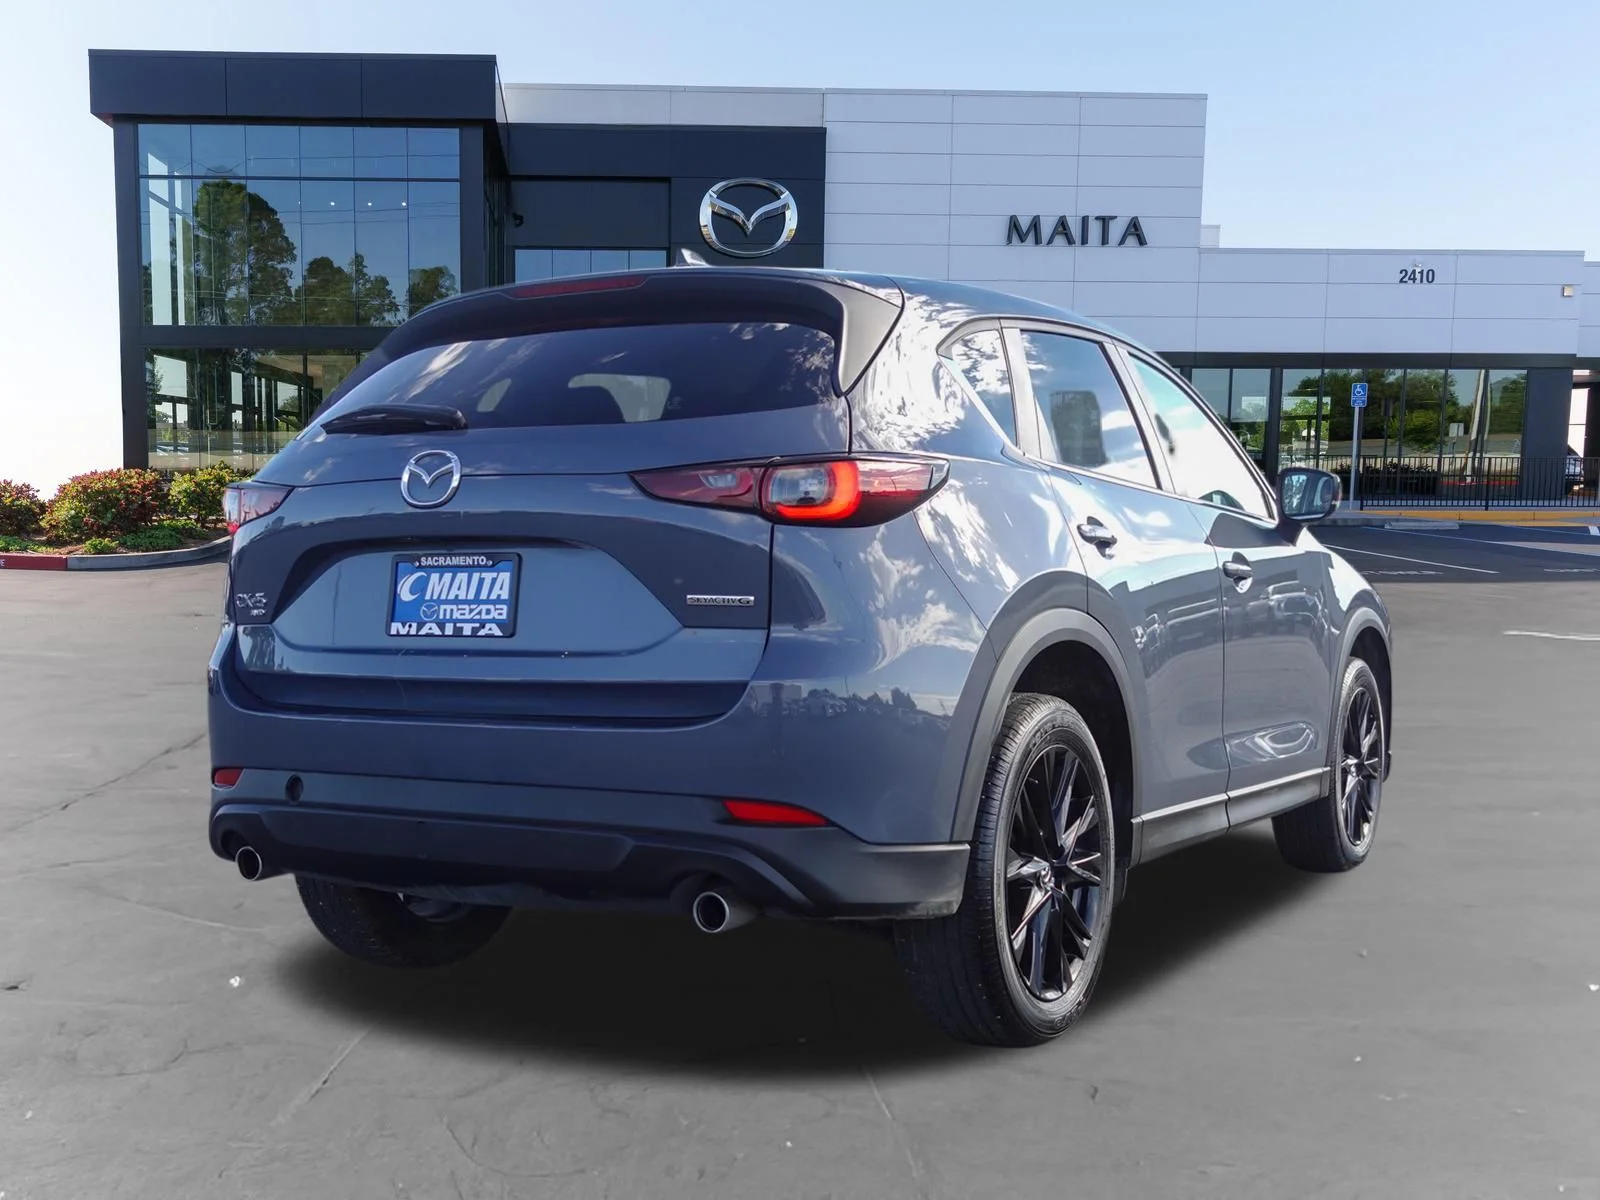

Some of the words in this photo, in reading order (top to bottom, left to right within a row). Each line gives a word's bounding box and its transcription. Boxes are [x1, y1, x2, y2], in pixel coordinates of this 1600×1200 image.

[1006, 214, 1148, 246] MAITA
[1399, 268, 1435, 284] 2410
[420, 556, 487, 566] SACRAMENTO
[424, 572, 511, 600] MAITA
[390, 622, 504, 636] MAITA
